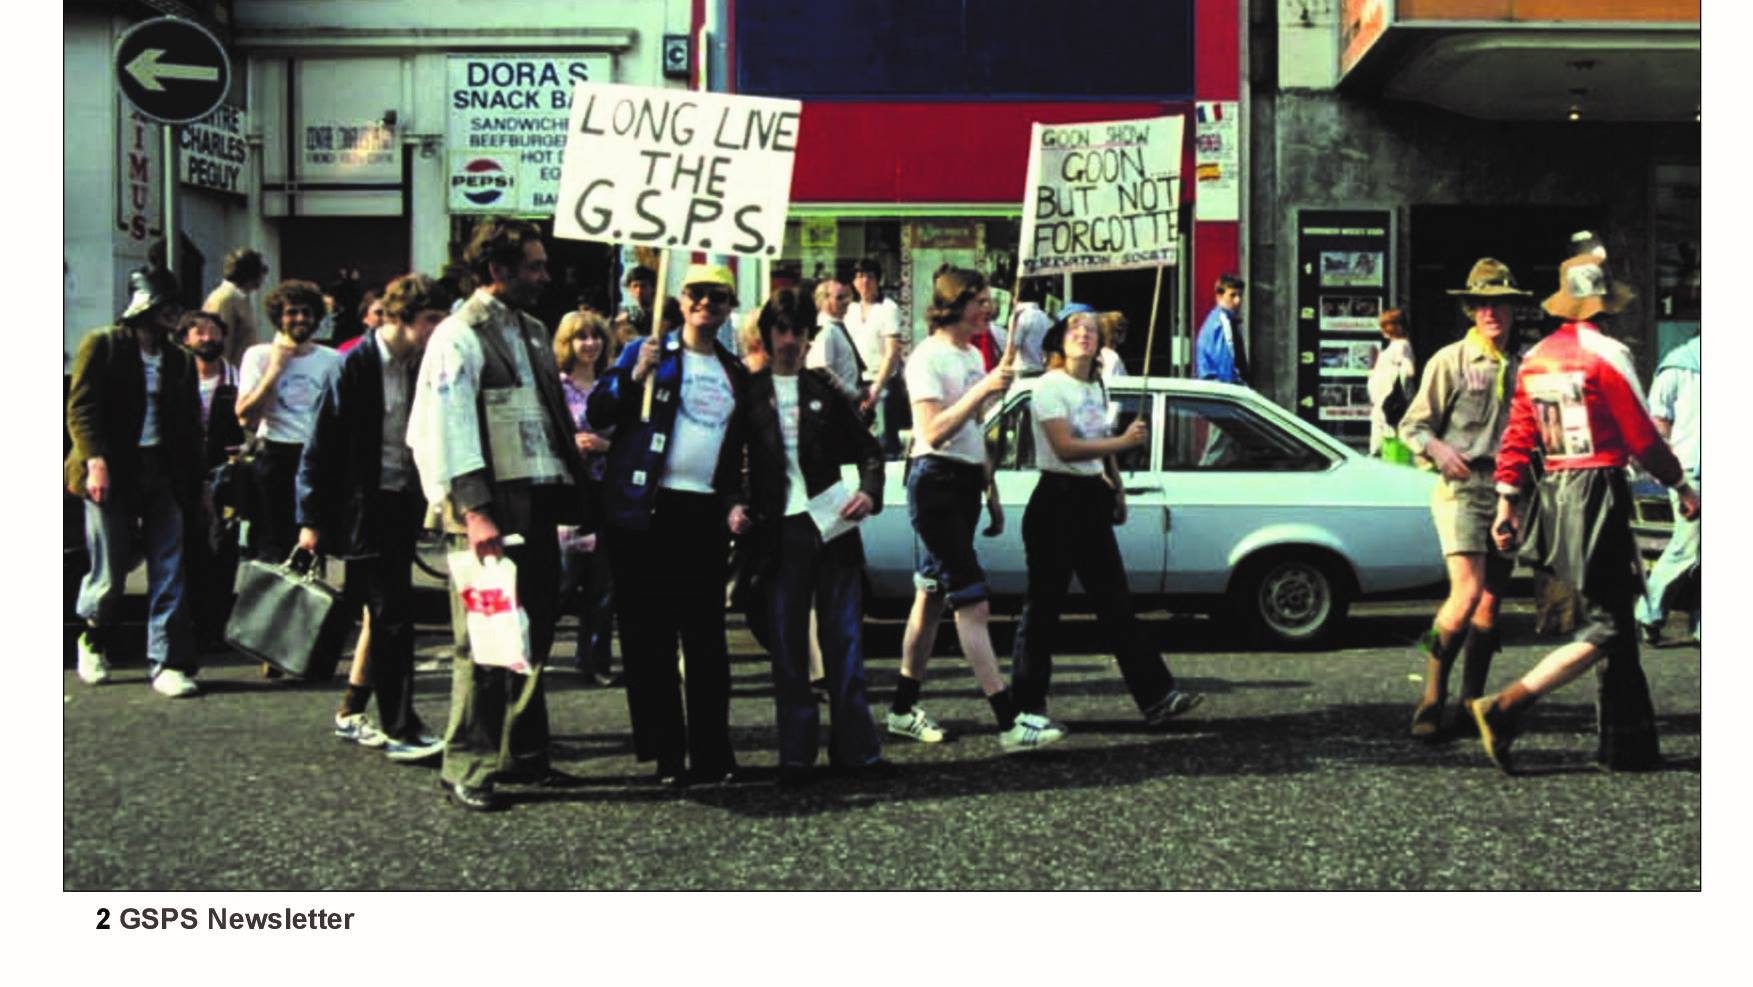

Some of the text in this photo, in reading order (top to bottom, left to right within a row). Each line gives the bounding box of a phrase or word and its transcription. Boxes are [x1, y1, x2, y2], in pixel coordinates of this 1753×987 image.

[453, 90, 540, 109] SNACK
[580, 94, 800, 151] LONG LIVE
[1041, 125, 1150, 147] GOON SHOW
[180, 126, 246, 164] CHARLES
[521, 150, 552, 164] HOT
[188, 155, 241, 191] PEGUY
[452, 175, 514, 187] PEPSI
[640, 150, 732, 198] THE
[533, 193, 558, 206] BA
[1035, 175, 1180, 219] BUT NOT
[574, 179, 776, 255] G.S.P.S.
